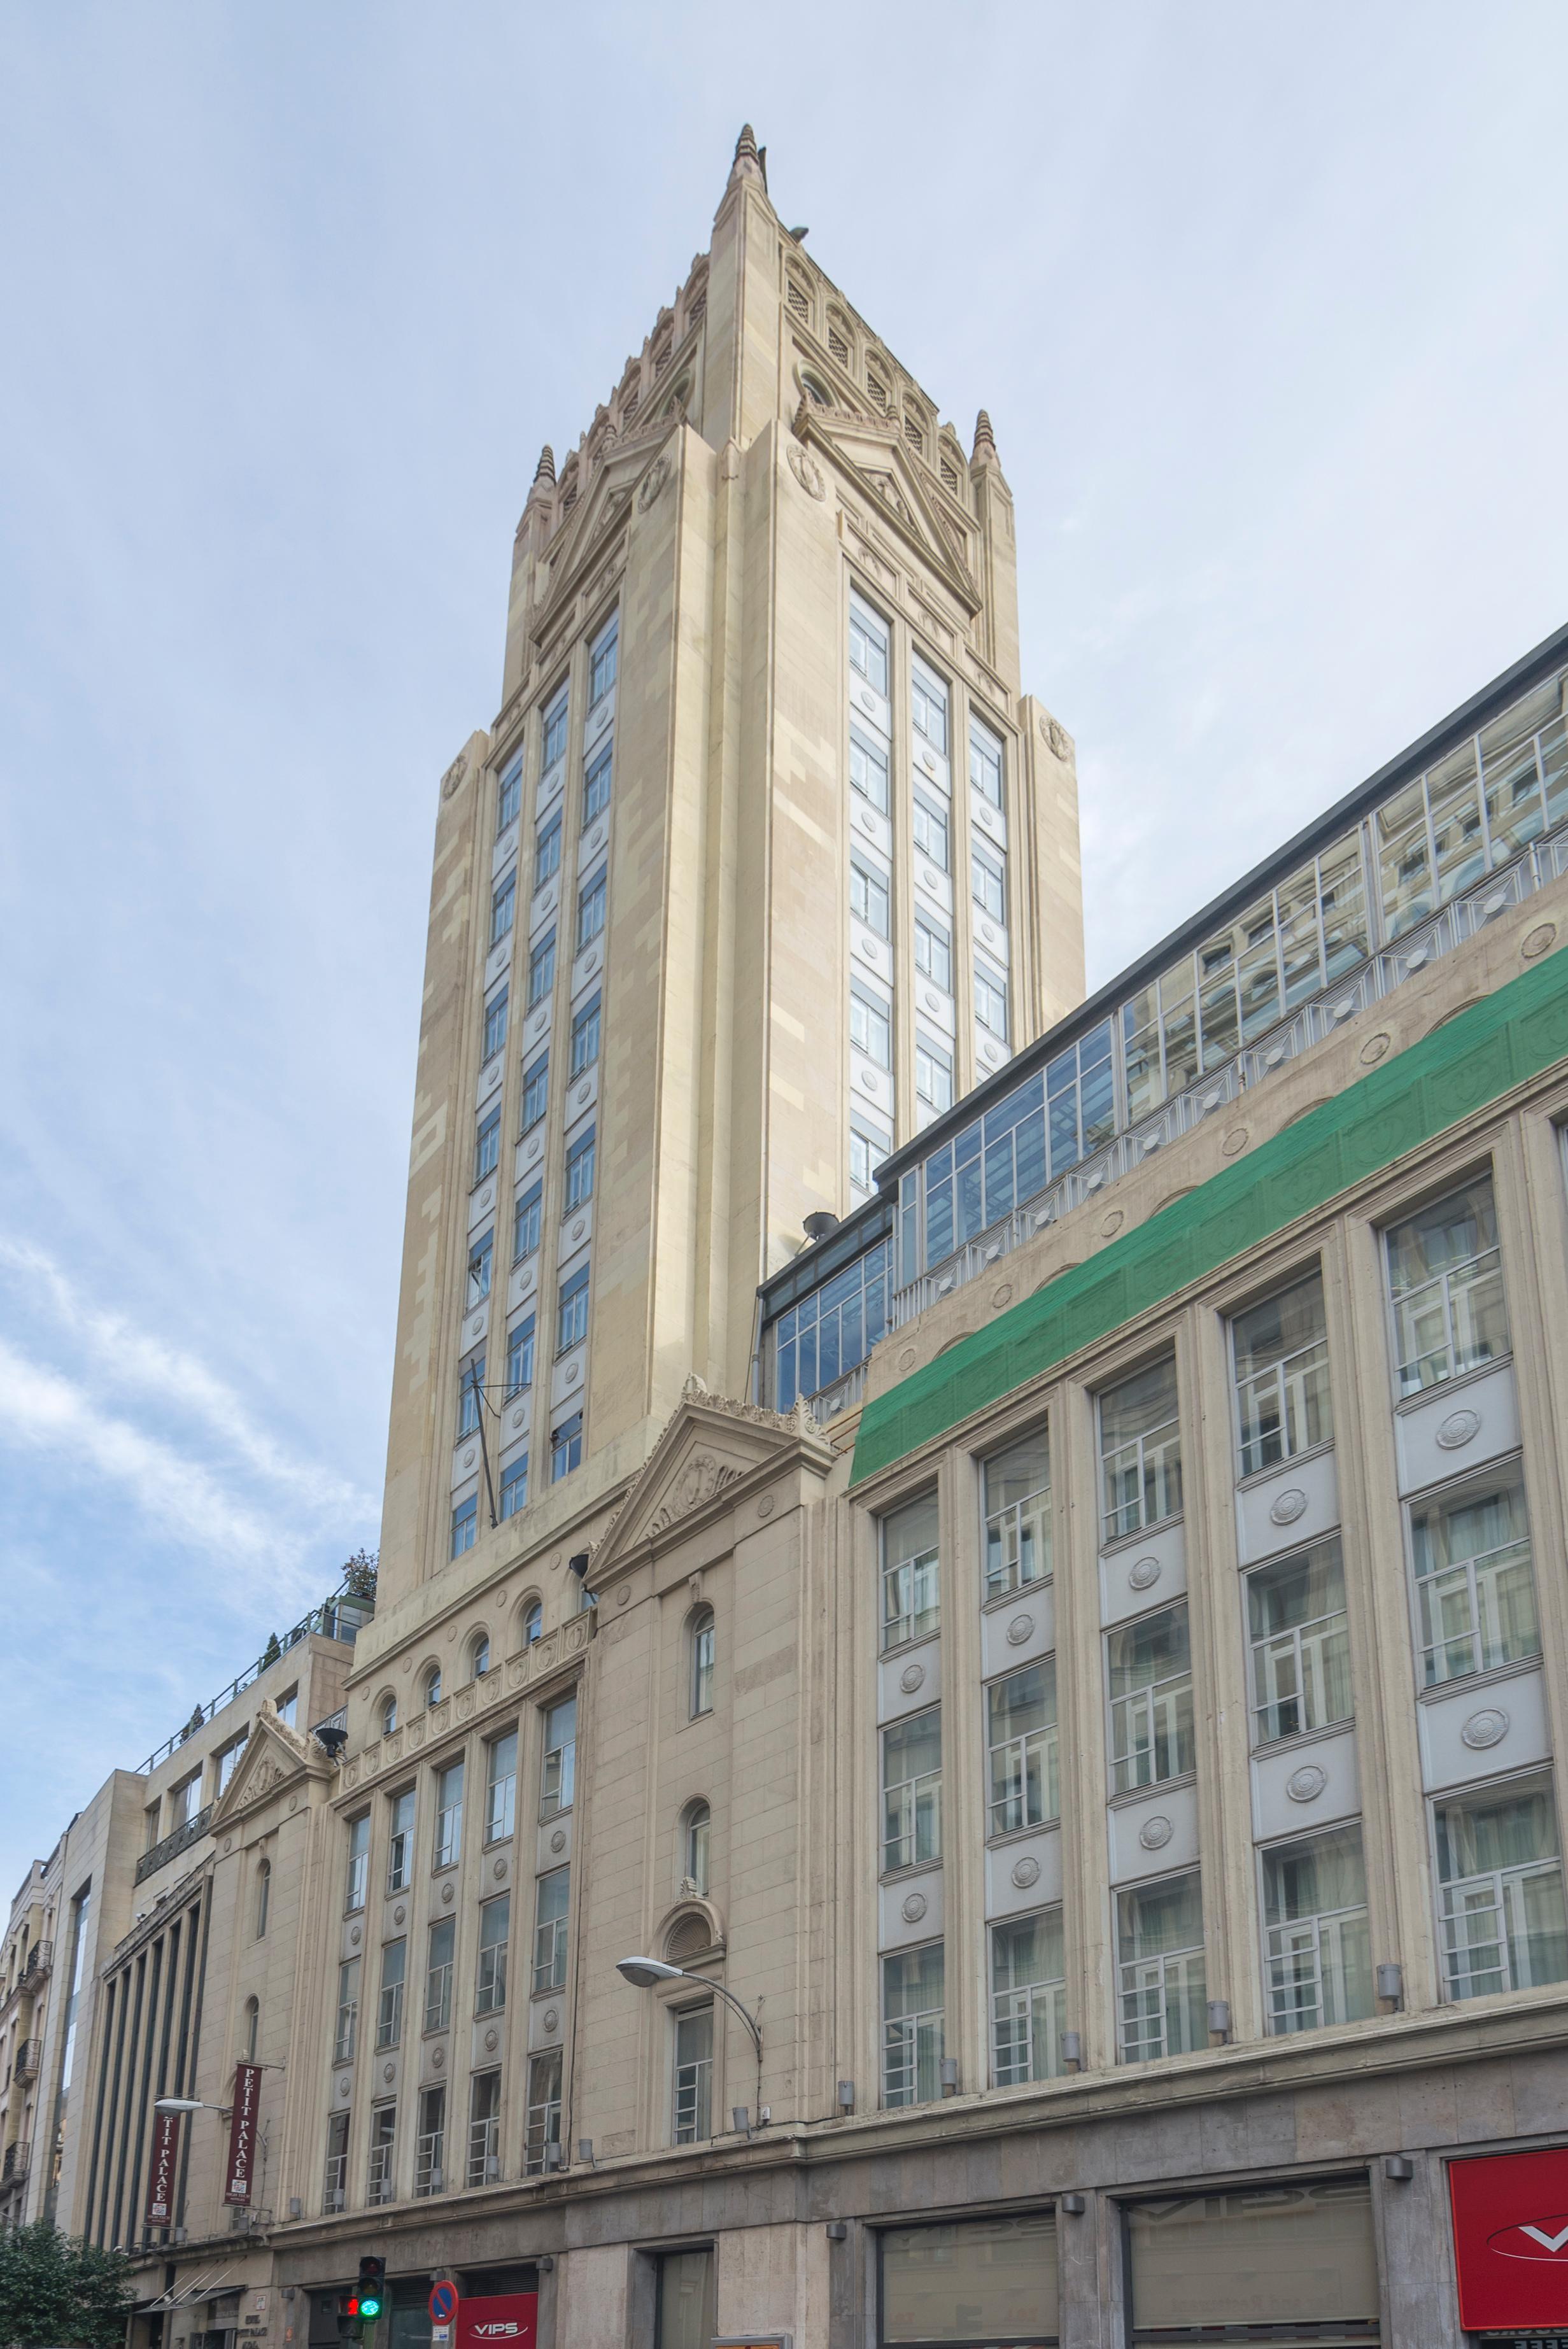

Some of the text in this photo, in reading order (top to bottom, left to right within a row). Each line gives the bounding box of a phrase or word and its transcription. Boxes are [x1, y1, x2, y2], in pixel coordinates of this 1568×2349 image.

[157, 2116, 173, 2201] TIT PALACE
[236, 2068, 255, 2178] PETIT PALACE
[474, 2322, 518, 2335] VIPS
